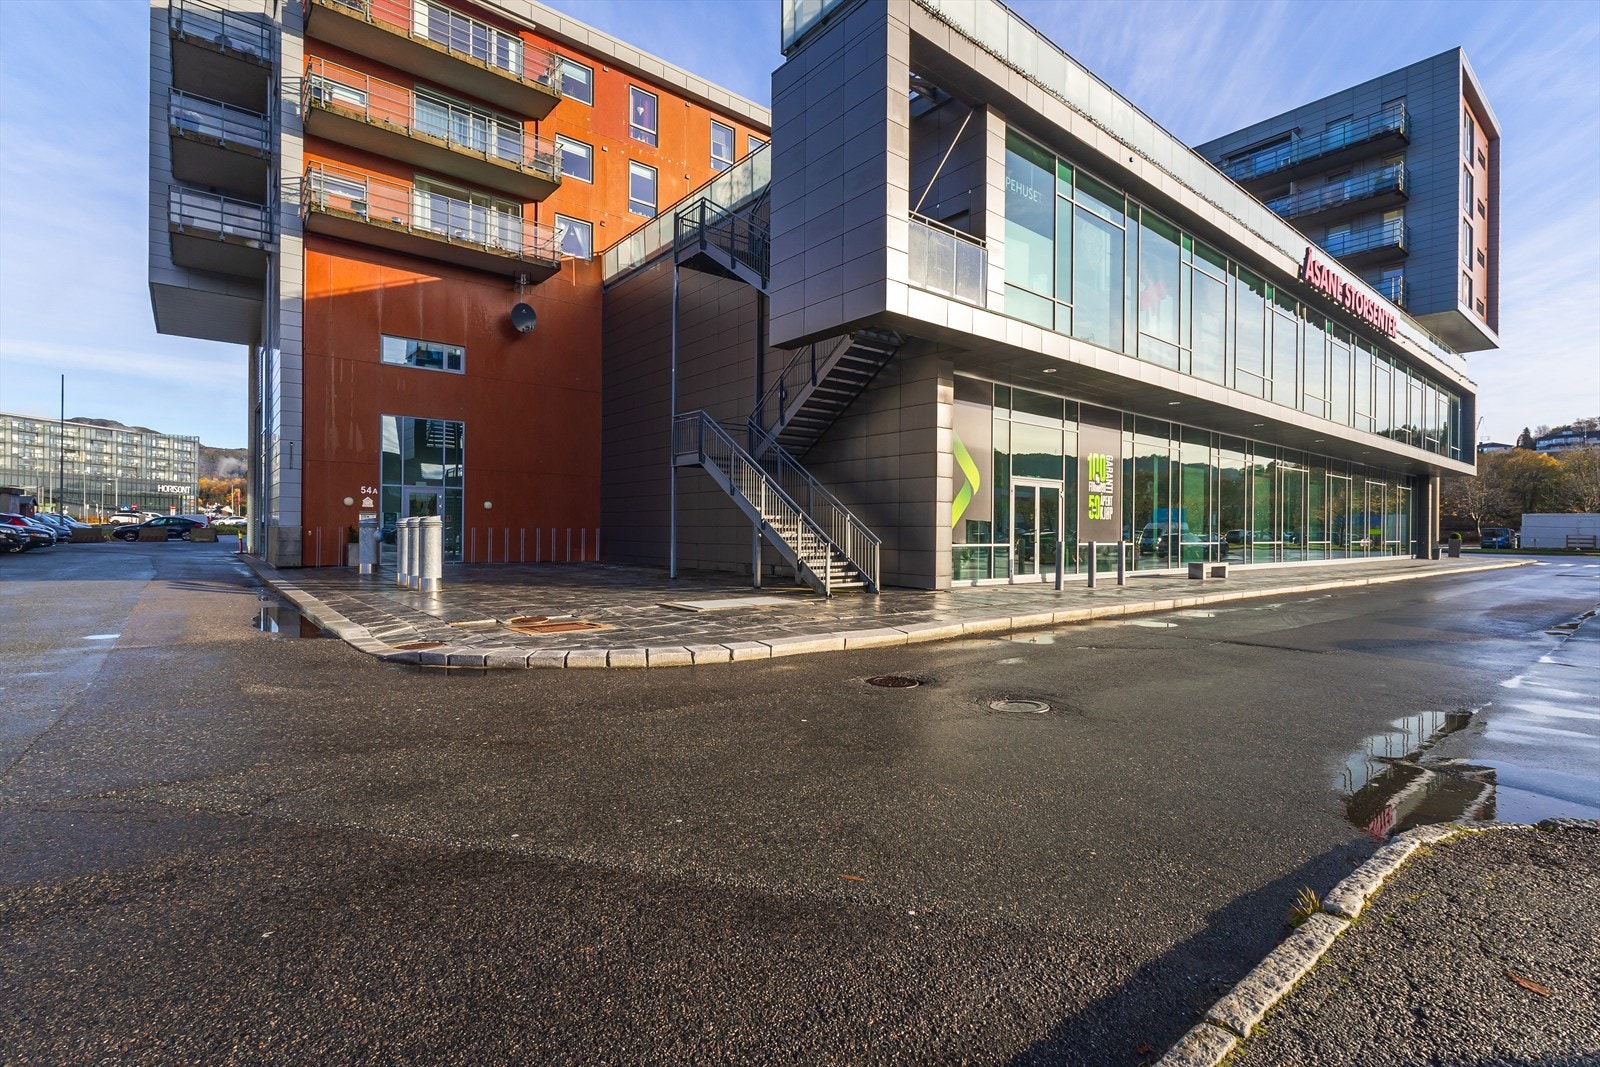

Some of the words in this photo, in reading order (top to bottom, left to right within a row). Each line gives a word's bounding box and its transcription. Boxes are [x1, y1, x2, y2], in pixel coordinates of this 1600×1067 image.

[1304, 247, 1342, 303] ÅSANE
[1344, 282, 1397, 338] STORSENTER
[1087, 452, 1106, 482] 100
[1106, 454, 1114, 494] GARANTI
[157, 484, 191, 494] HORISONT
[360, 486, 378, 494] 54A
[1088, 494, 1101, 520] 50
